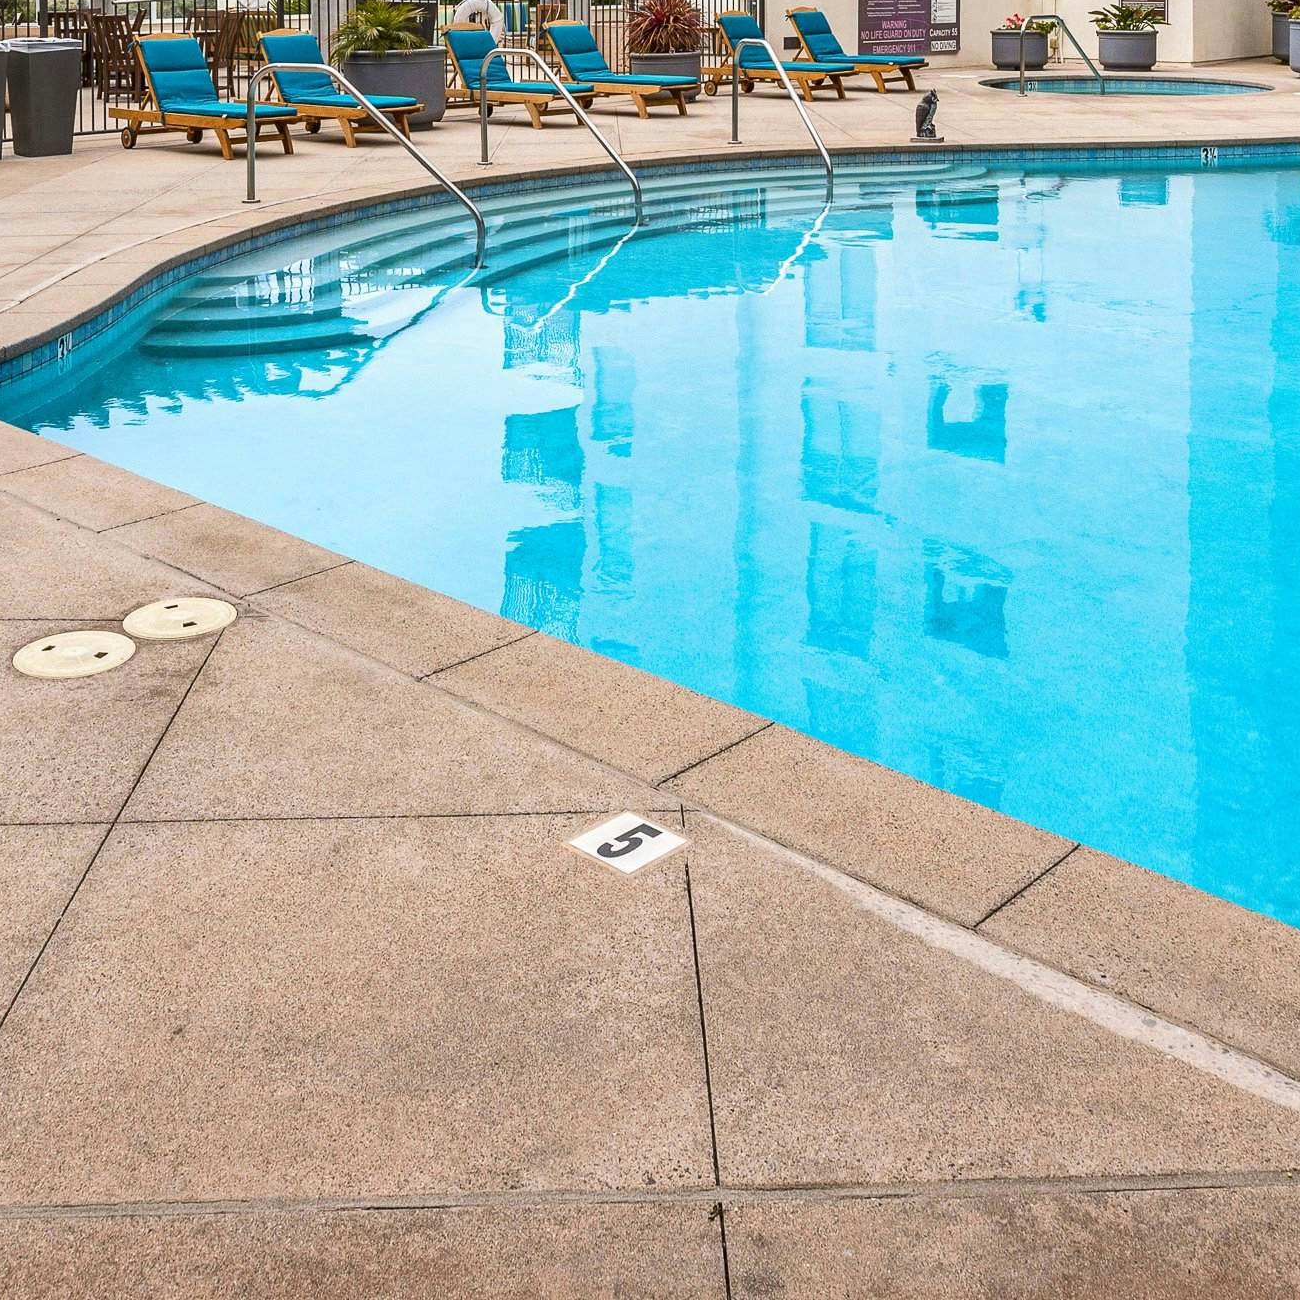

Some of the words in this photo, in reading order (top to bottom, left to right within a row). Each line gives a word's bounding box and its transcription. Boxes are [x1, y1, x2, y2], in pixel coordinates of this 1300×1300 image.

[882, 20, 907, 28] WARNING
[861, 31, 869, 39] NO
[904, 29, 911, 38] ON
[912, 29, 926, 37] DUTY
[930, 29, 951, 37] CAPACITY
[951, 28, 957, 36] 55
[873, 44, 906, 54] EMERGENCY
[907, 44, 915, 53] 911
[931, 42, 938, 50] NO
[939, 41, 956, 49] DIVING
[596, 822, 664, 858] 5
